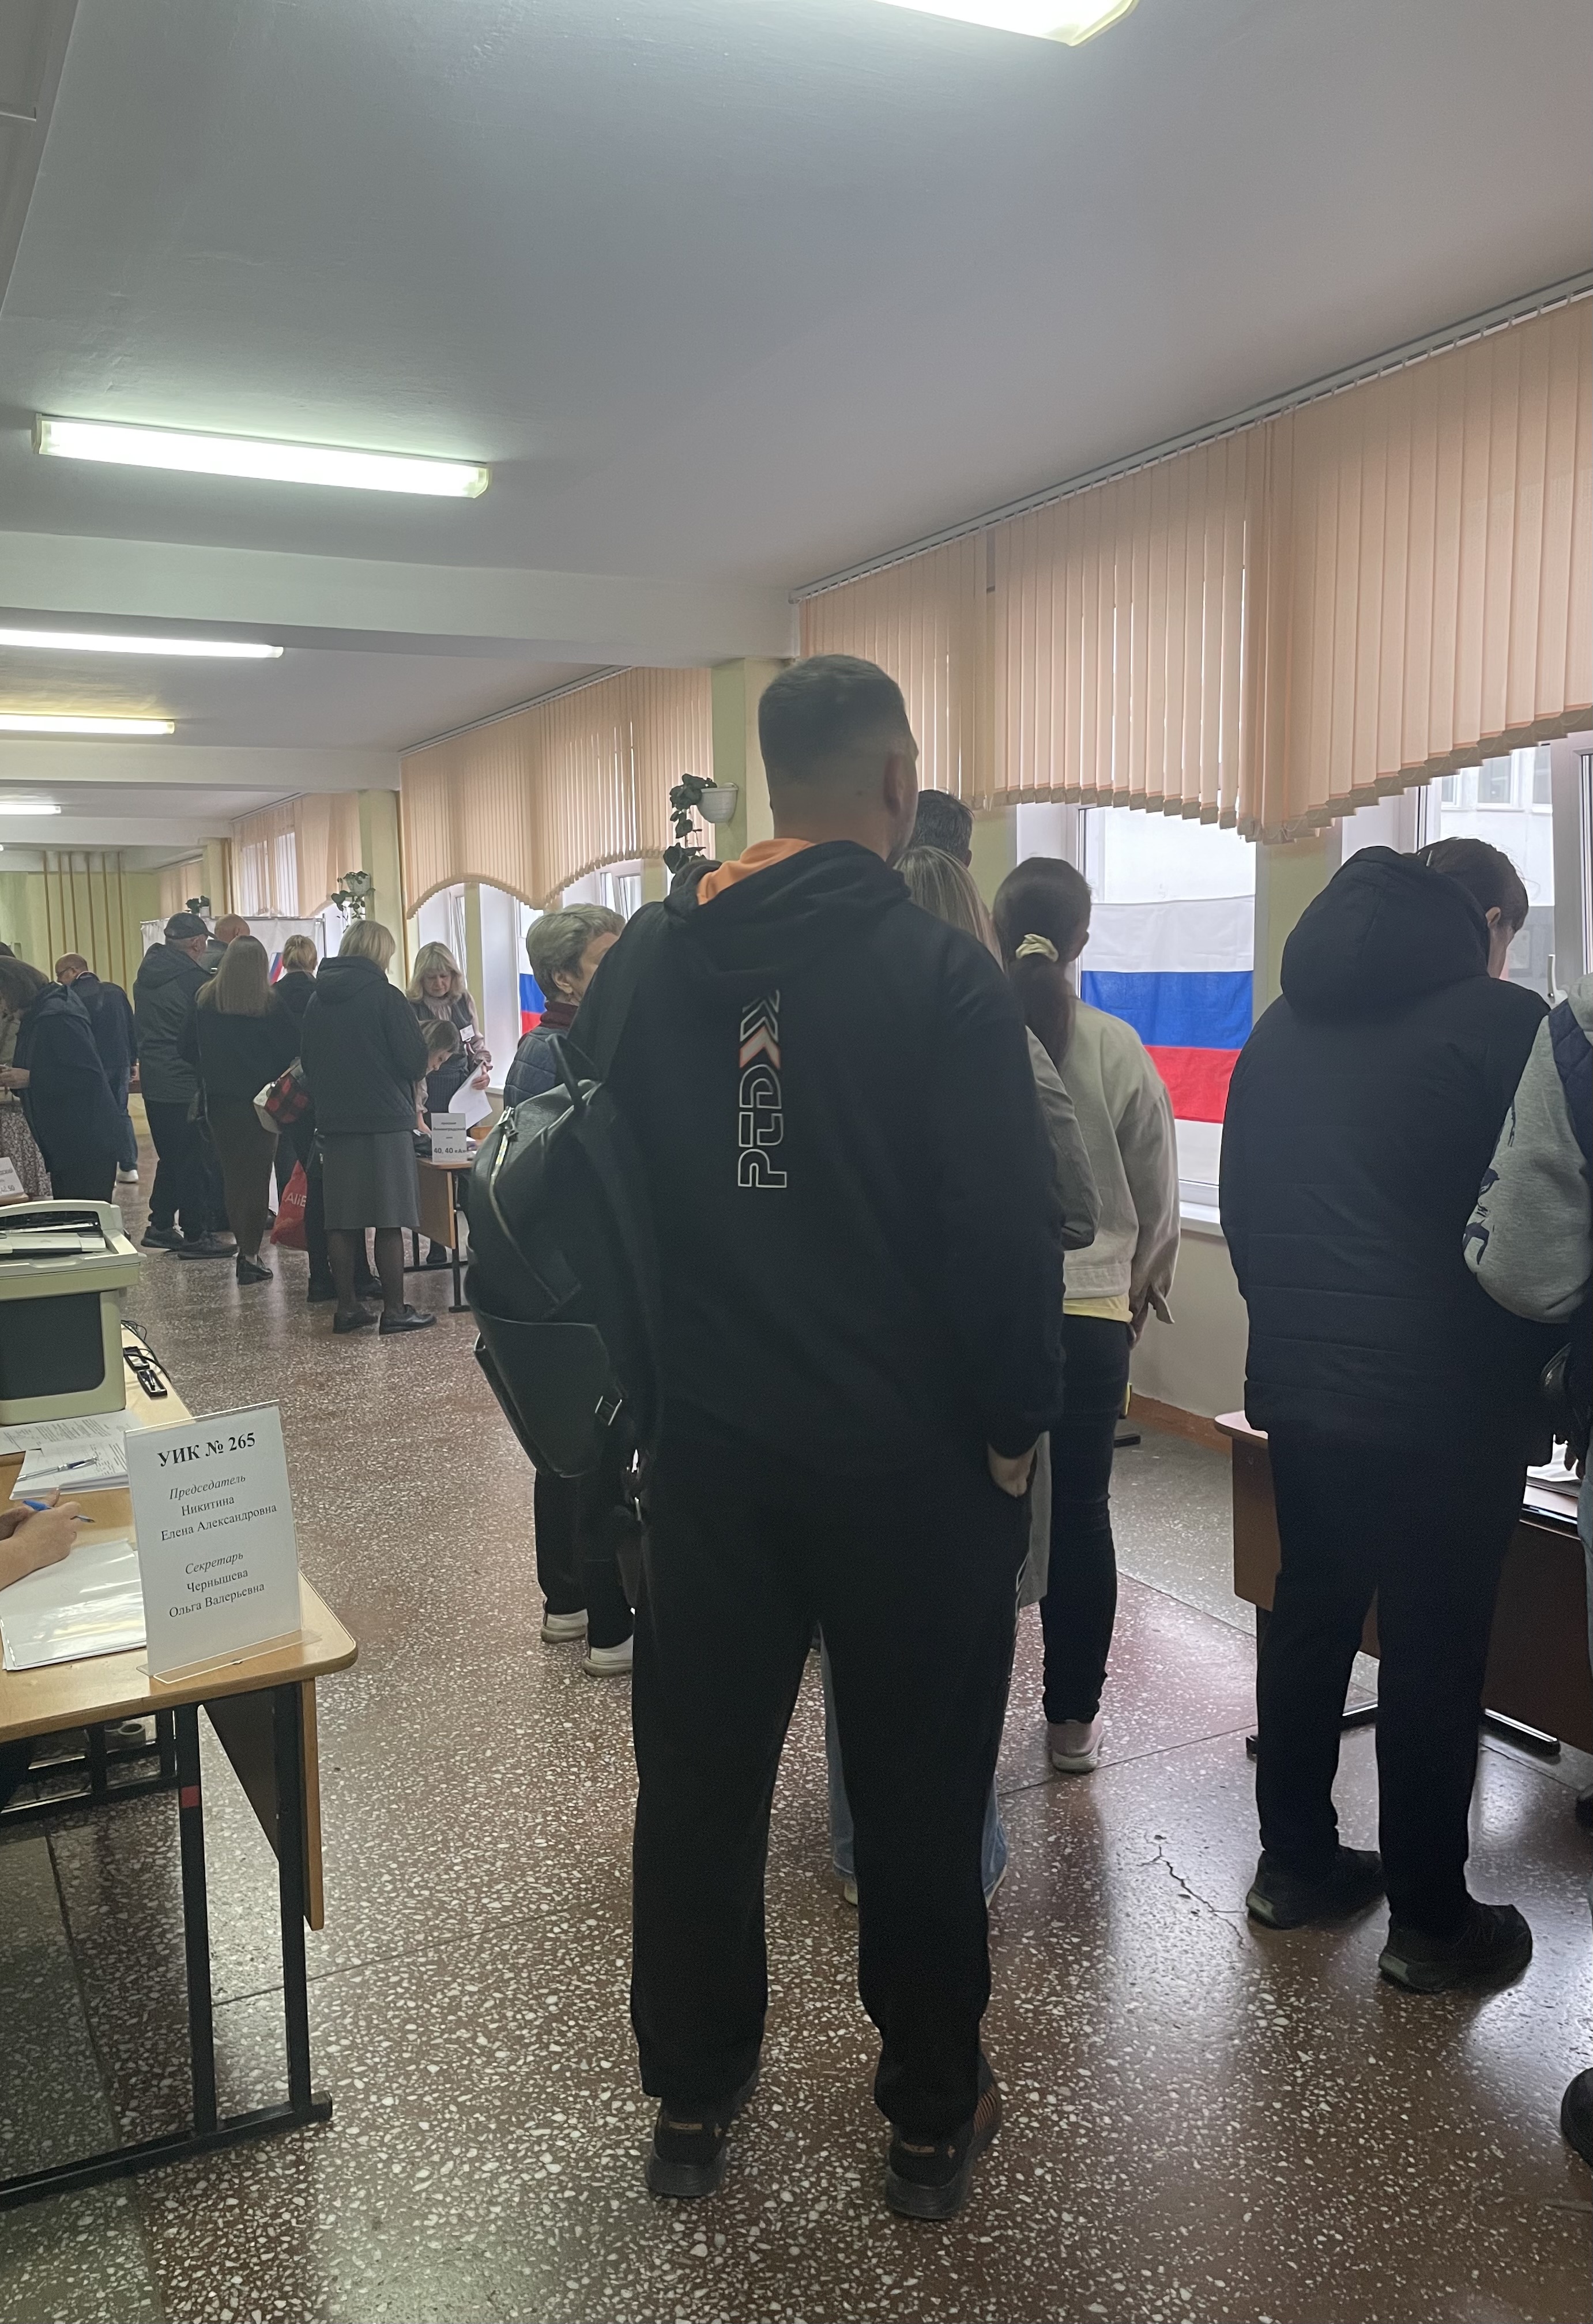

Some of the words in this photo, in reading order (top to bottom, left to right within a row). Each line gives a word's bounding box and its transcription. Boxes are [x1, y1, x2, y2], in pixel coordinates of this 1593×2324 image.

[157, 1445, 201, 1467] УИК
[205, 1440, 224, 1457] №
[228, 1432, 255, 1452] 265
[169, 1475, 246, 1501] Председатель
[181, 1496, 235, 1516] Никитина
[161, 1526, 194, 1542] Елена
[197, 1505, 277, 1532] Александровна
[185, 1553, 244, 1575] Секретарь
[187, 1570, 248, 1593] Чернышева
[169, 1602, 202, 1618] Ольга
[205, 1584, 265, 1608] Валерьевна
